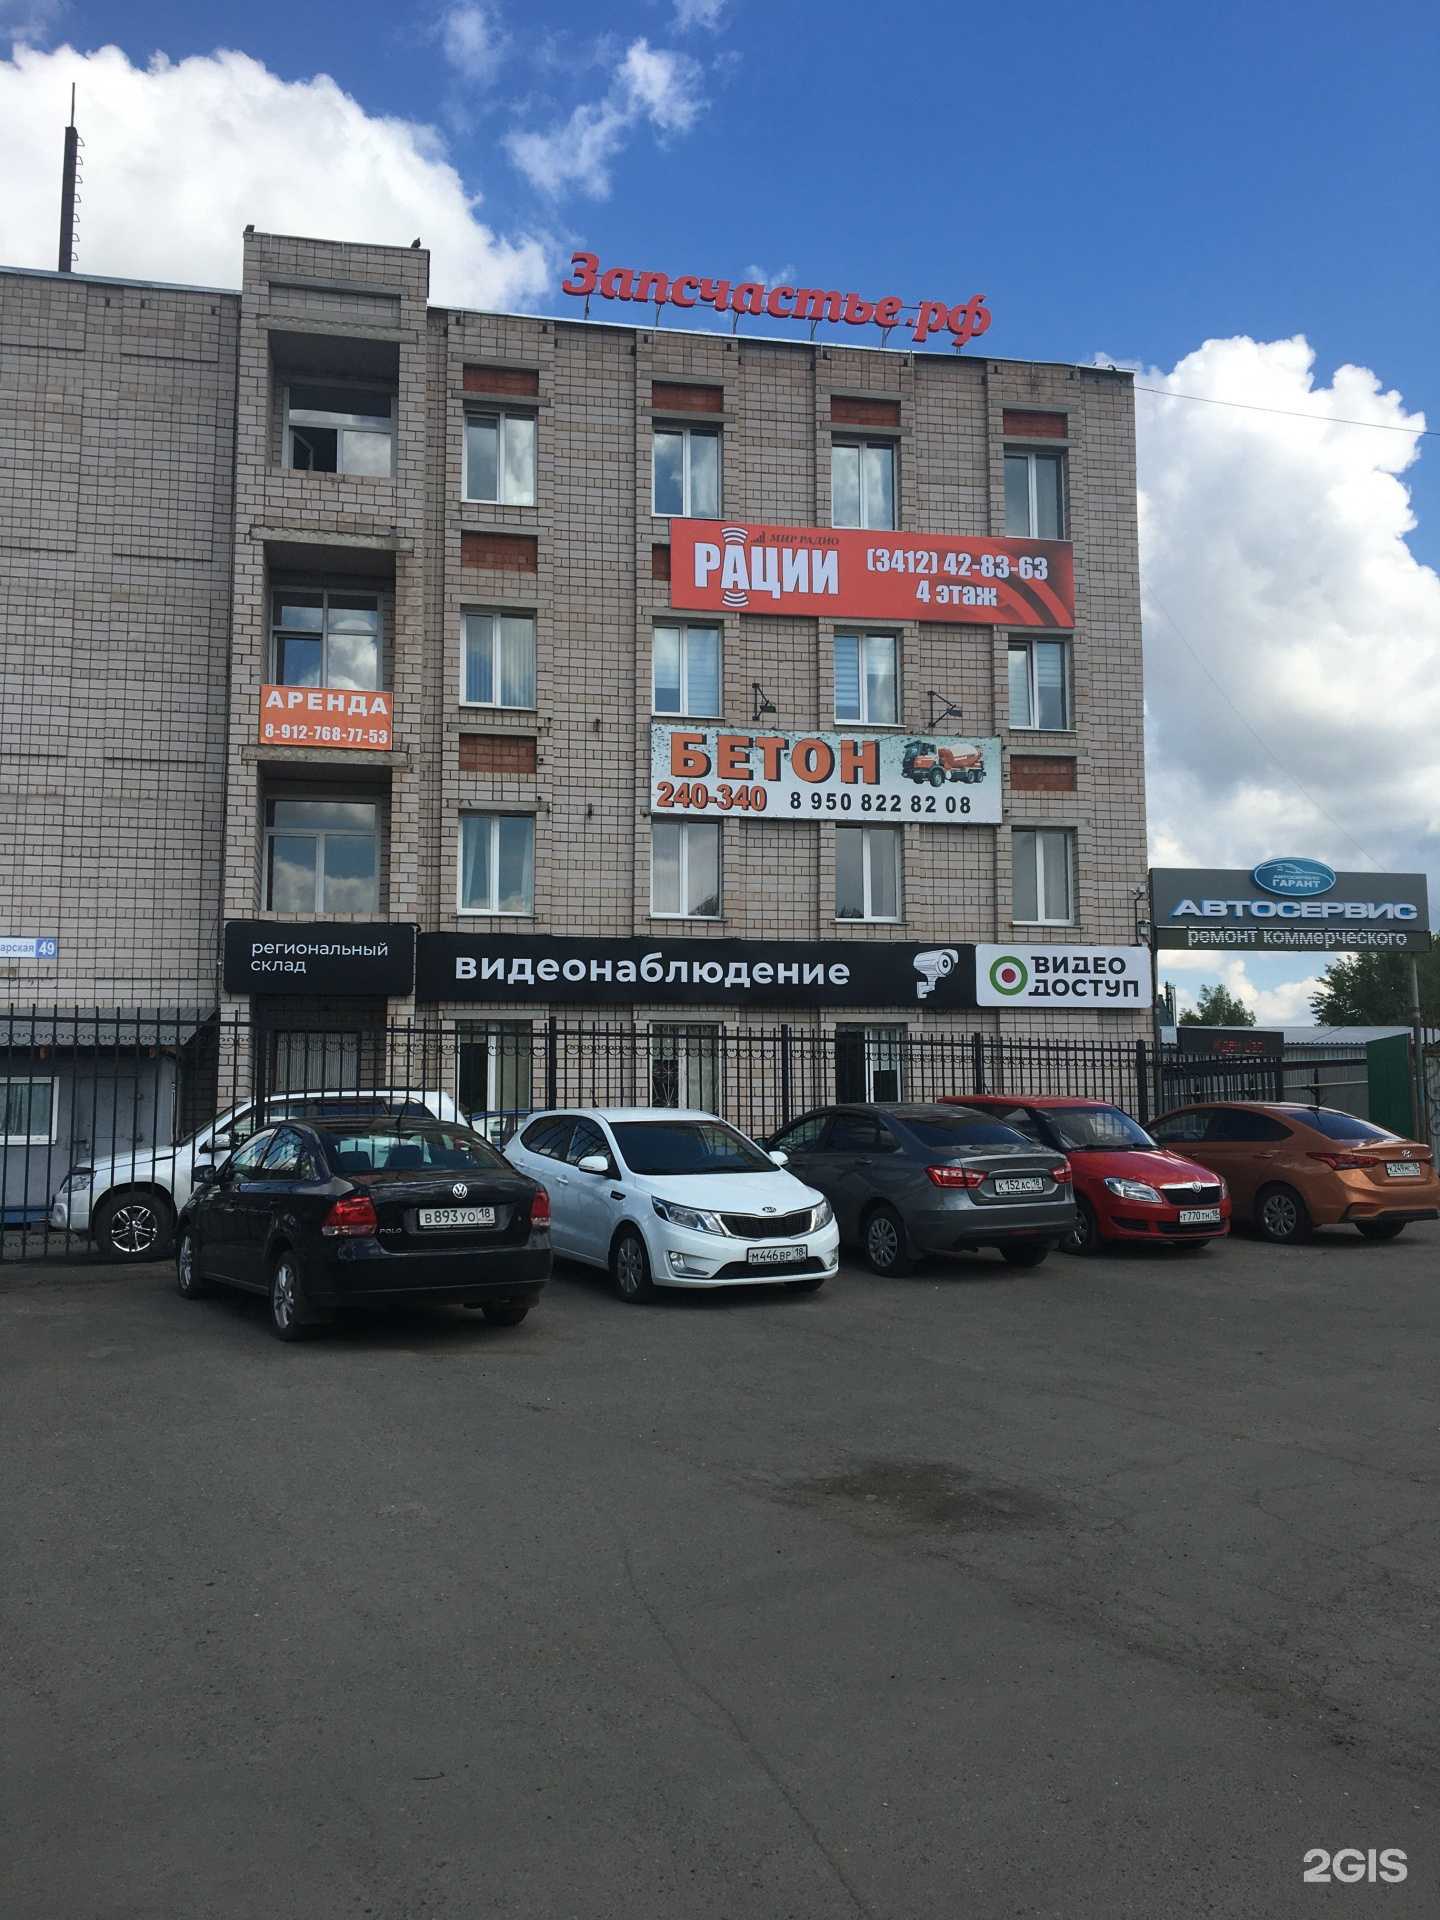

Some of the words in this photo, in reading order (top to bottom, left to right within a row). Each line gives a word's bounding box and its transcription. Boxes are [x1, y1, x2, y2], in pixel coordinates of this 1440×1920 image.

[562, 251, 992, 346] Запсчастье.рф
[768, 534, 798, 545] МИР
[800, 535, 840, 547] РАДИО
[693, 542, 840, 600] РАЦИИ
[866, 547, 938, 575] (3412)
[943, 552, 1049, 581] 42-83-63
[915, 580, 931, 604] 4
[935, 583, 998, 607] этаж
[265, 690, 389, 717] АРЕНДА
[264, 723, 388, 744] 8-912-768-77-53
[670, 731, 881, 786] БЕТОН
[656, 781, 768, 812] 240-340
[790, 792, 802, 809] 8
[811, 792, 852, 811] 950
[861, 793, 902, 812] 822
[910, 795, 937, 813] 82
[945, 796, 972, 814] 08
[1272, 879, 1321, 888] ГАРАНТ
[1171, 899, 1418, 920] АВТОСЕРВИС
[39, 941, 55, 956] 49
[1187, 929, 1258, 946] ремонт
[1263, 930, 1408, 948] коммерческого
[251, 942, 388, 957] региональный
[250, 960, 307, 974] склад
[455, 951, 851, 988] видеонаблюдение
[1030, 956, 1127, 975] ВИДЕО
[1028, 978, 1139, 998] ДОСТУП
[424, 1210, 476, 1224] В893УО
[479, 1208, 491, 1218] 18
[751, 1249, 792, 1262] М446ВР
[795, 1247, 804, 1257] 18
